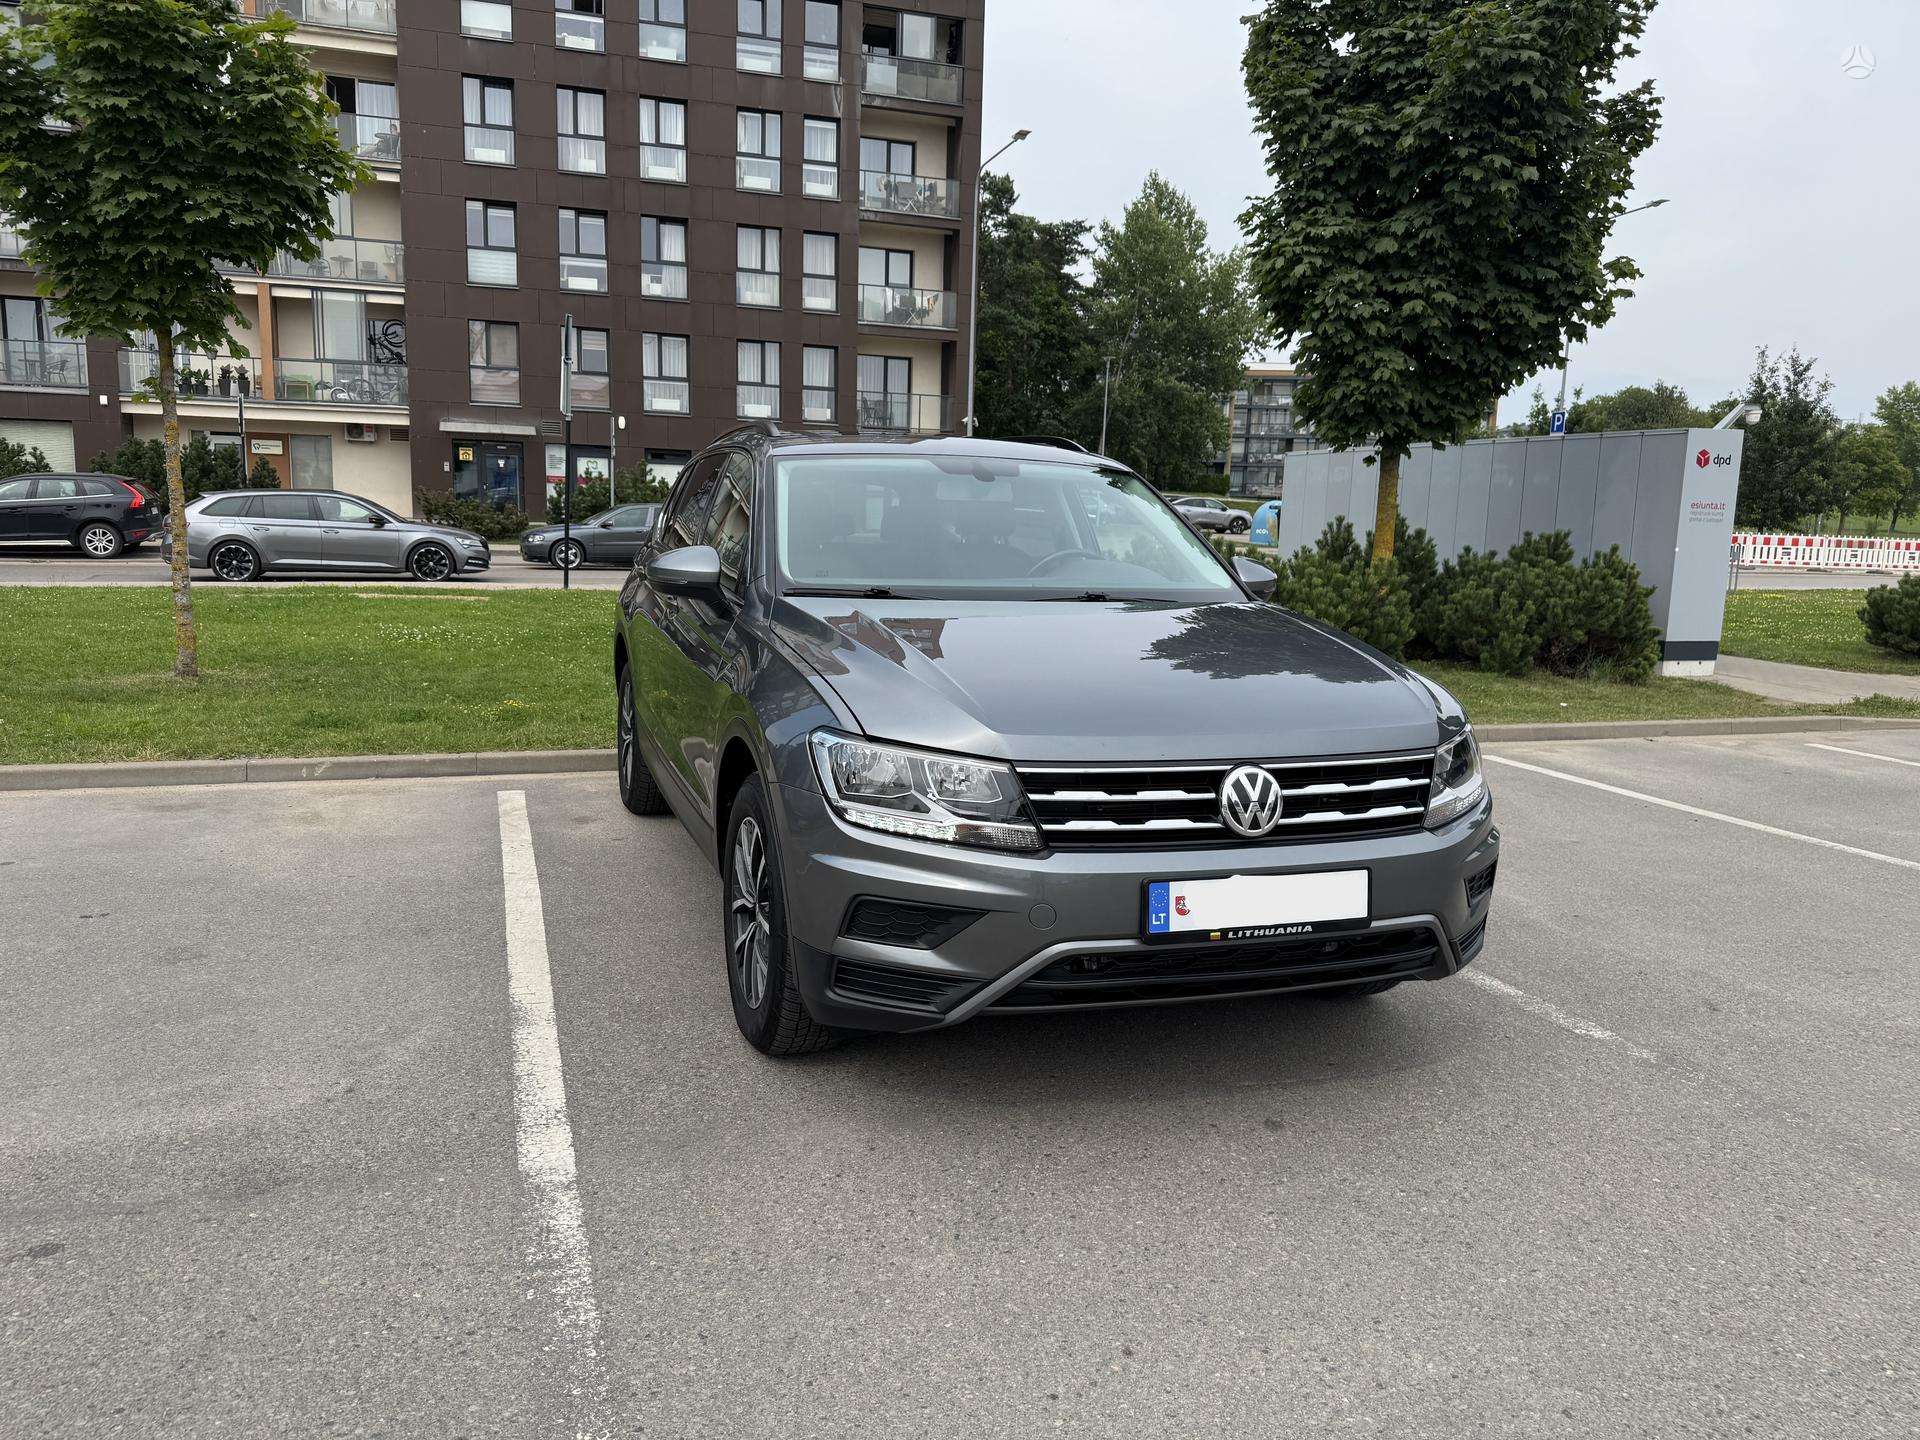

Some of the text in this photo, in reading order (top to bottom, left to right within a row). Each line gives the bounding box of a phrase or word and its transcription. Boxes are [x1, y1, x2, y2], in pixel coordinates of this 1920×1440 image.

[1553, 413, 1563, 431] P
[1713, 454, 1732, 467] dpd
[1225, 769, 1280, 834] VW
[1152, 913, 1167, 925] LT
[1227, 925, 1313, 939] LITHUANIA
